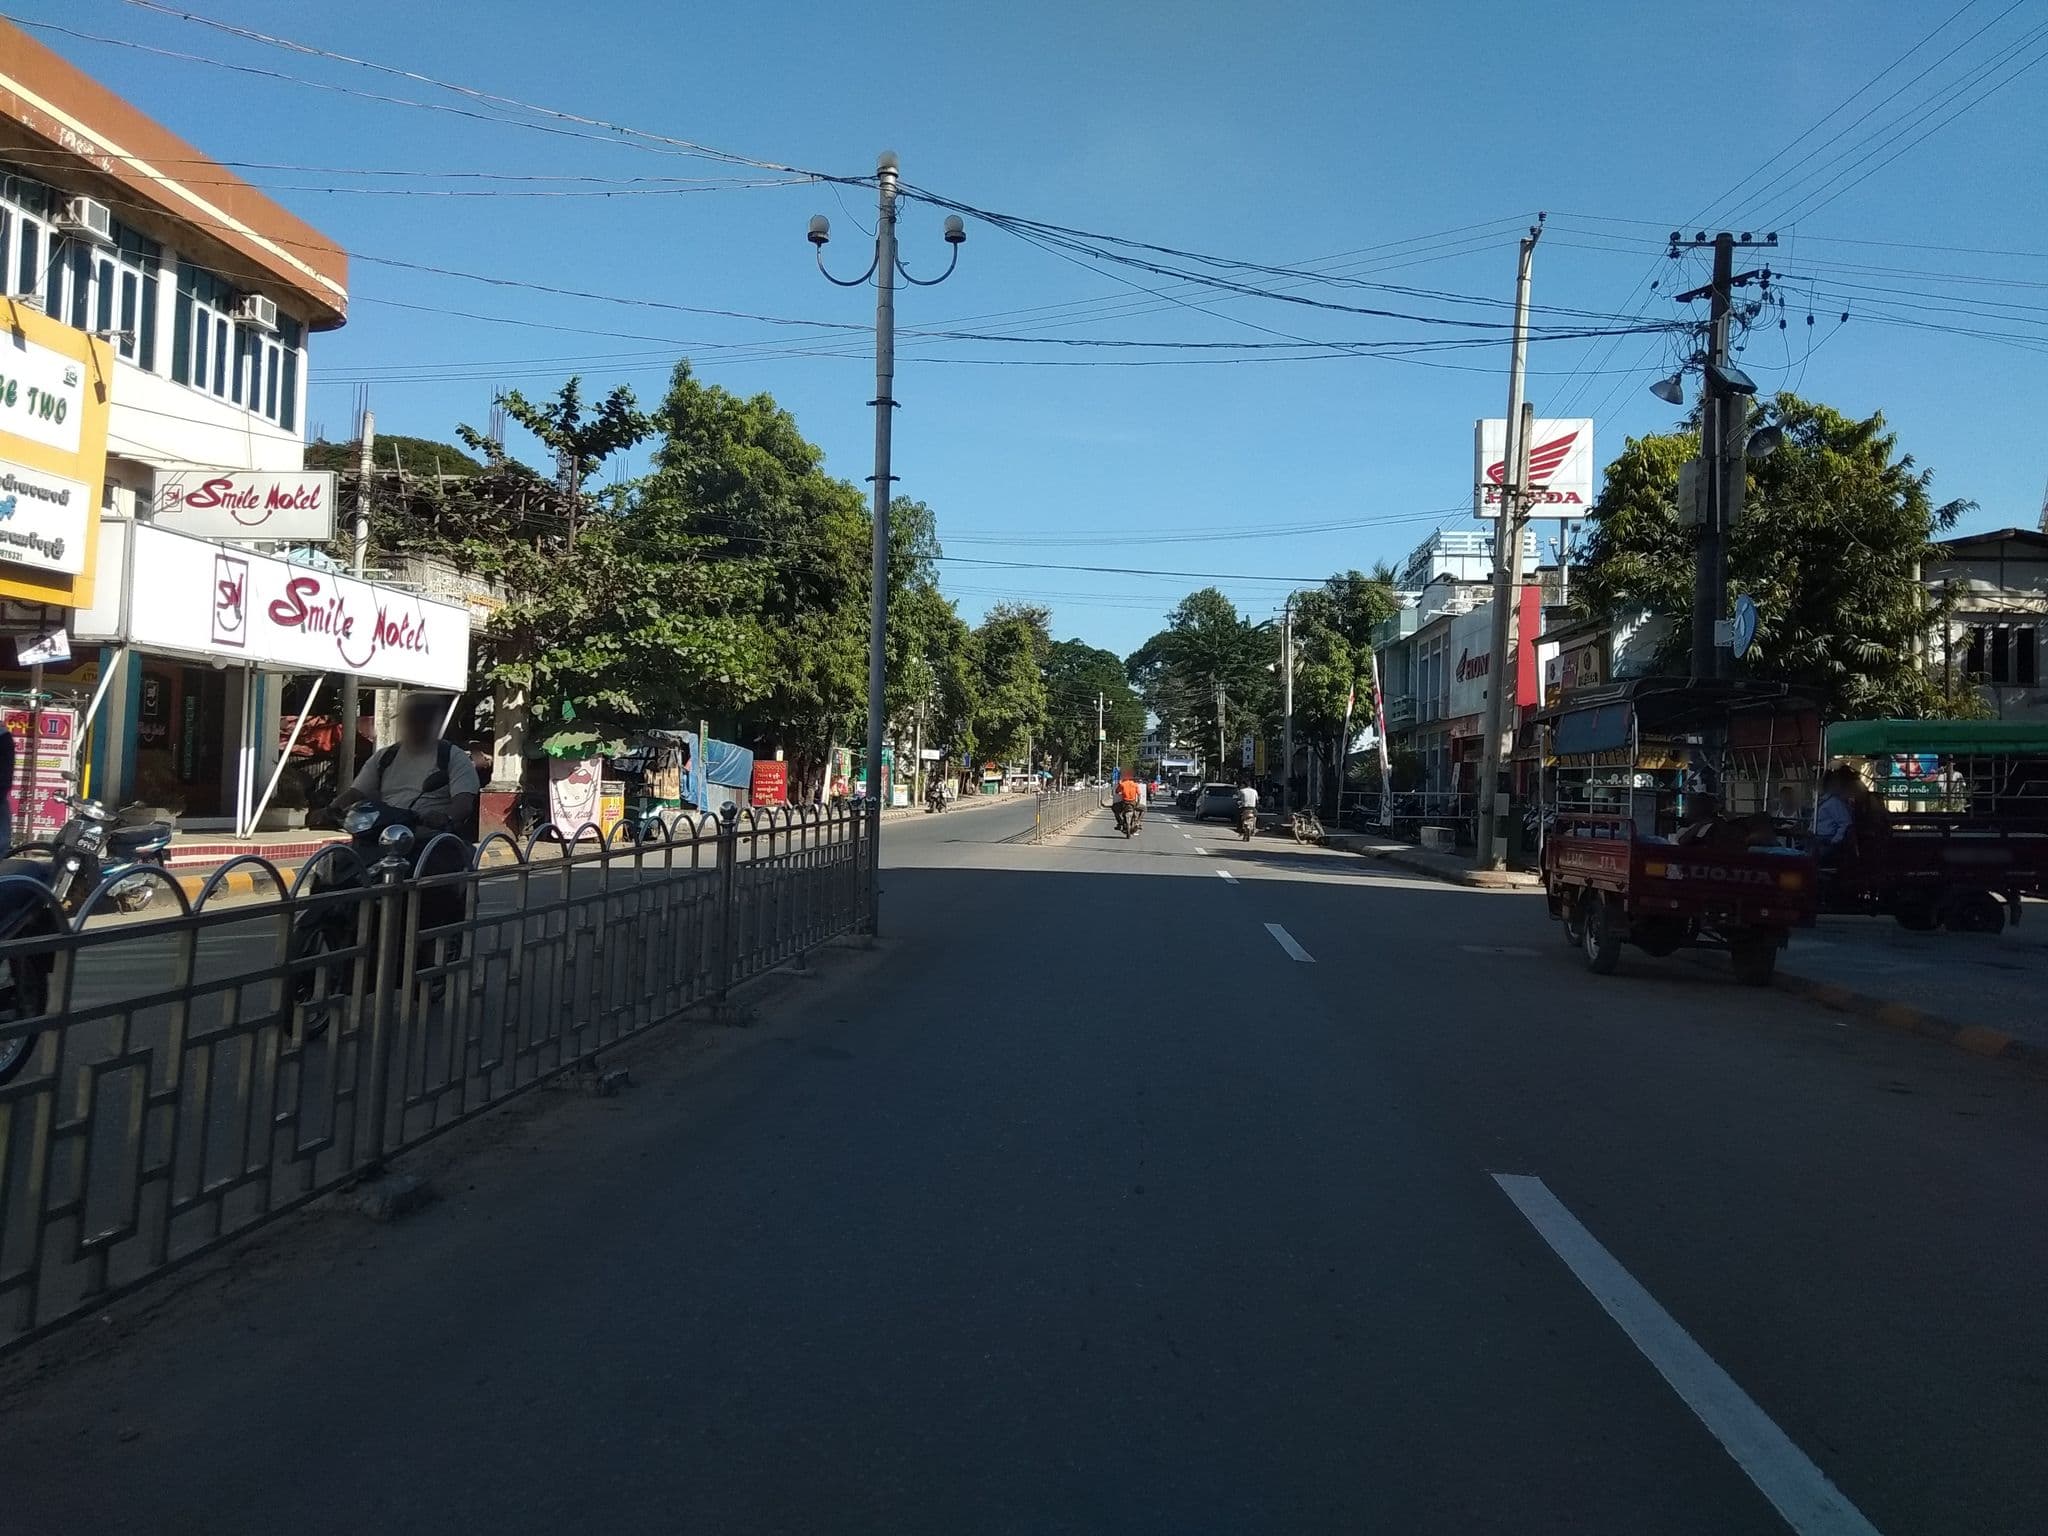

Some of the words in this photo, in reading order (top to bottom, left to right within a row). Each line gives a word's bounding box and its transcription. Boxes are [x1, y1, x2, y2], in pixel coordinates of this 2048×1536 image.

[27, 387, 67, 425] TWO
[186, 479, 258, 510] Smile
[264, 482, 321, 510] Motel
[1485, 491, 1583, 504] HNDA
[268, 577, 354, 639] Smile
[373, 604, 429, 655] Motel
